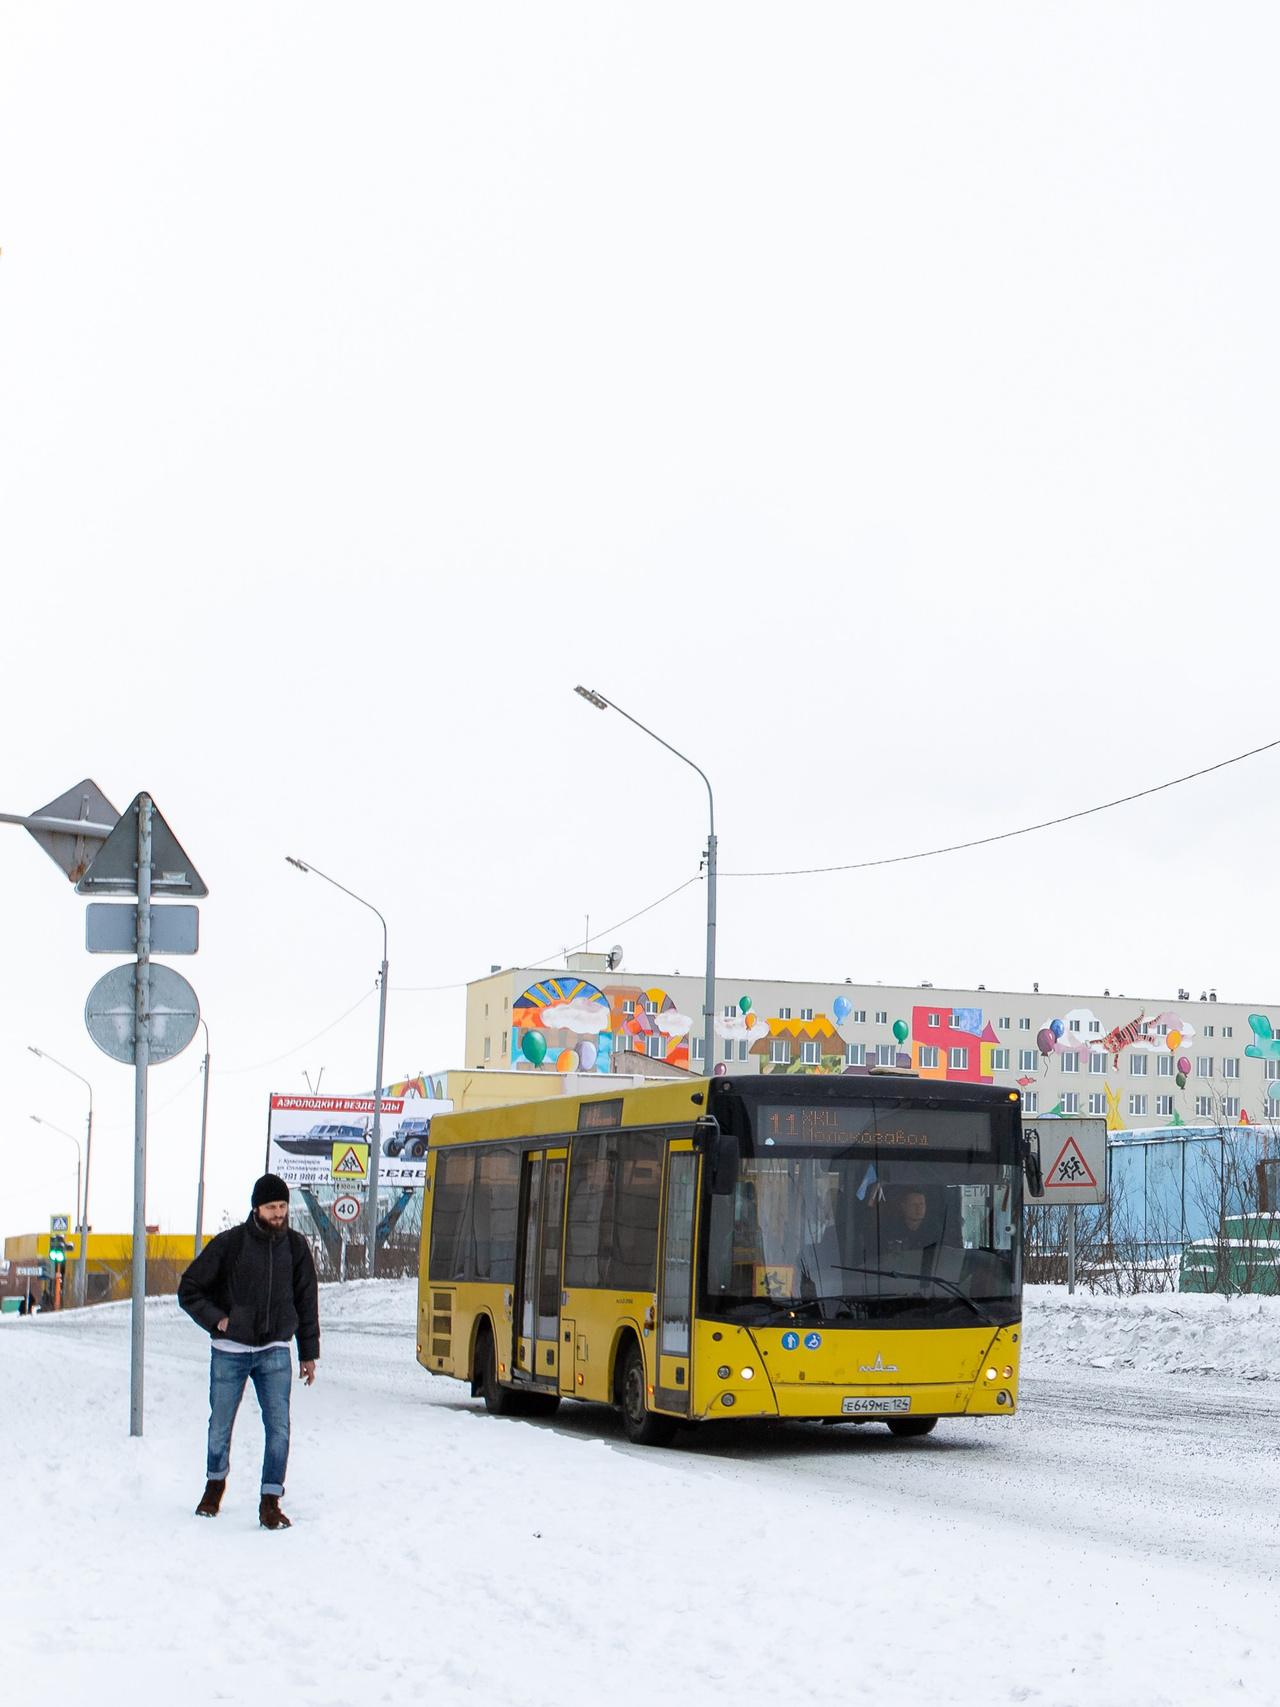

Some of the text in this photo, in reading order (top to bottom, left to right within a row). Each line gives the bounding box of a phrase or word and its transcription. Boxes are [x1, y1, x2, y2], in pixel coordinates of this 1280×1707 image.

[277, 1099, 400, 1111] АЭРОЛОДКИ И ВЕЗДЕОДЫ
[769, 1113, 798, 1136] 11
[802, 1110, 838, 1126] ХКЦ
[802, 1126, 929, 1146] Молокозавод
[338, 1204, 354, 1214] 40
[846, 1399, 909, 1411] Е649МЕ 124
